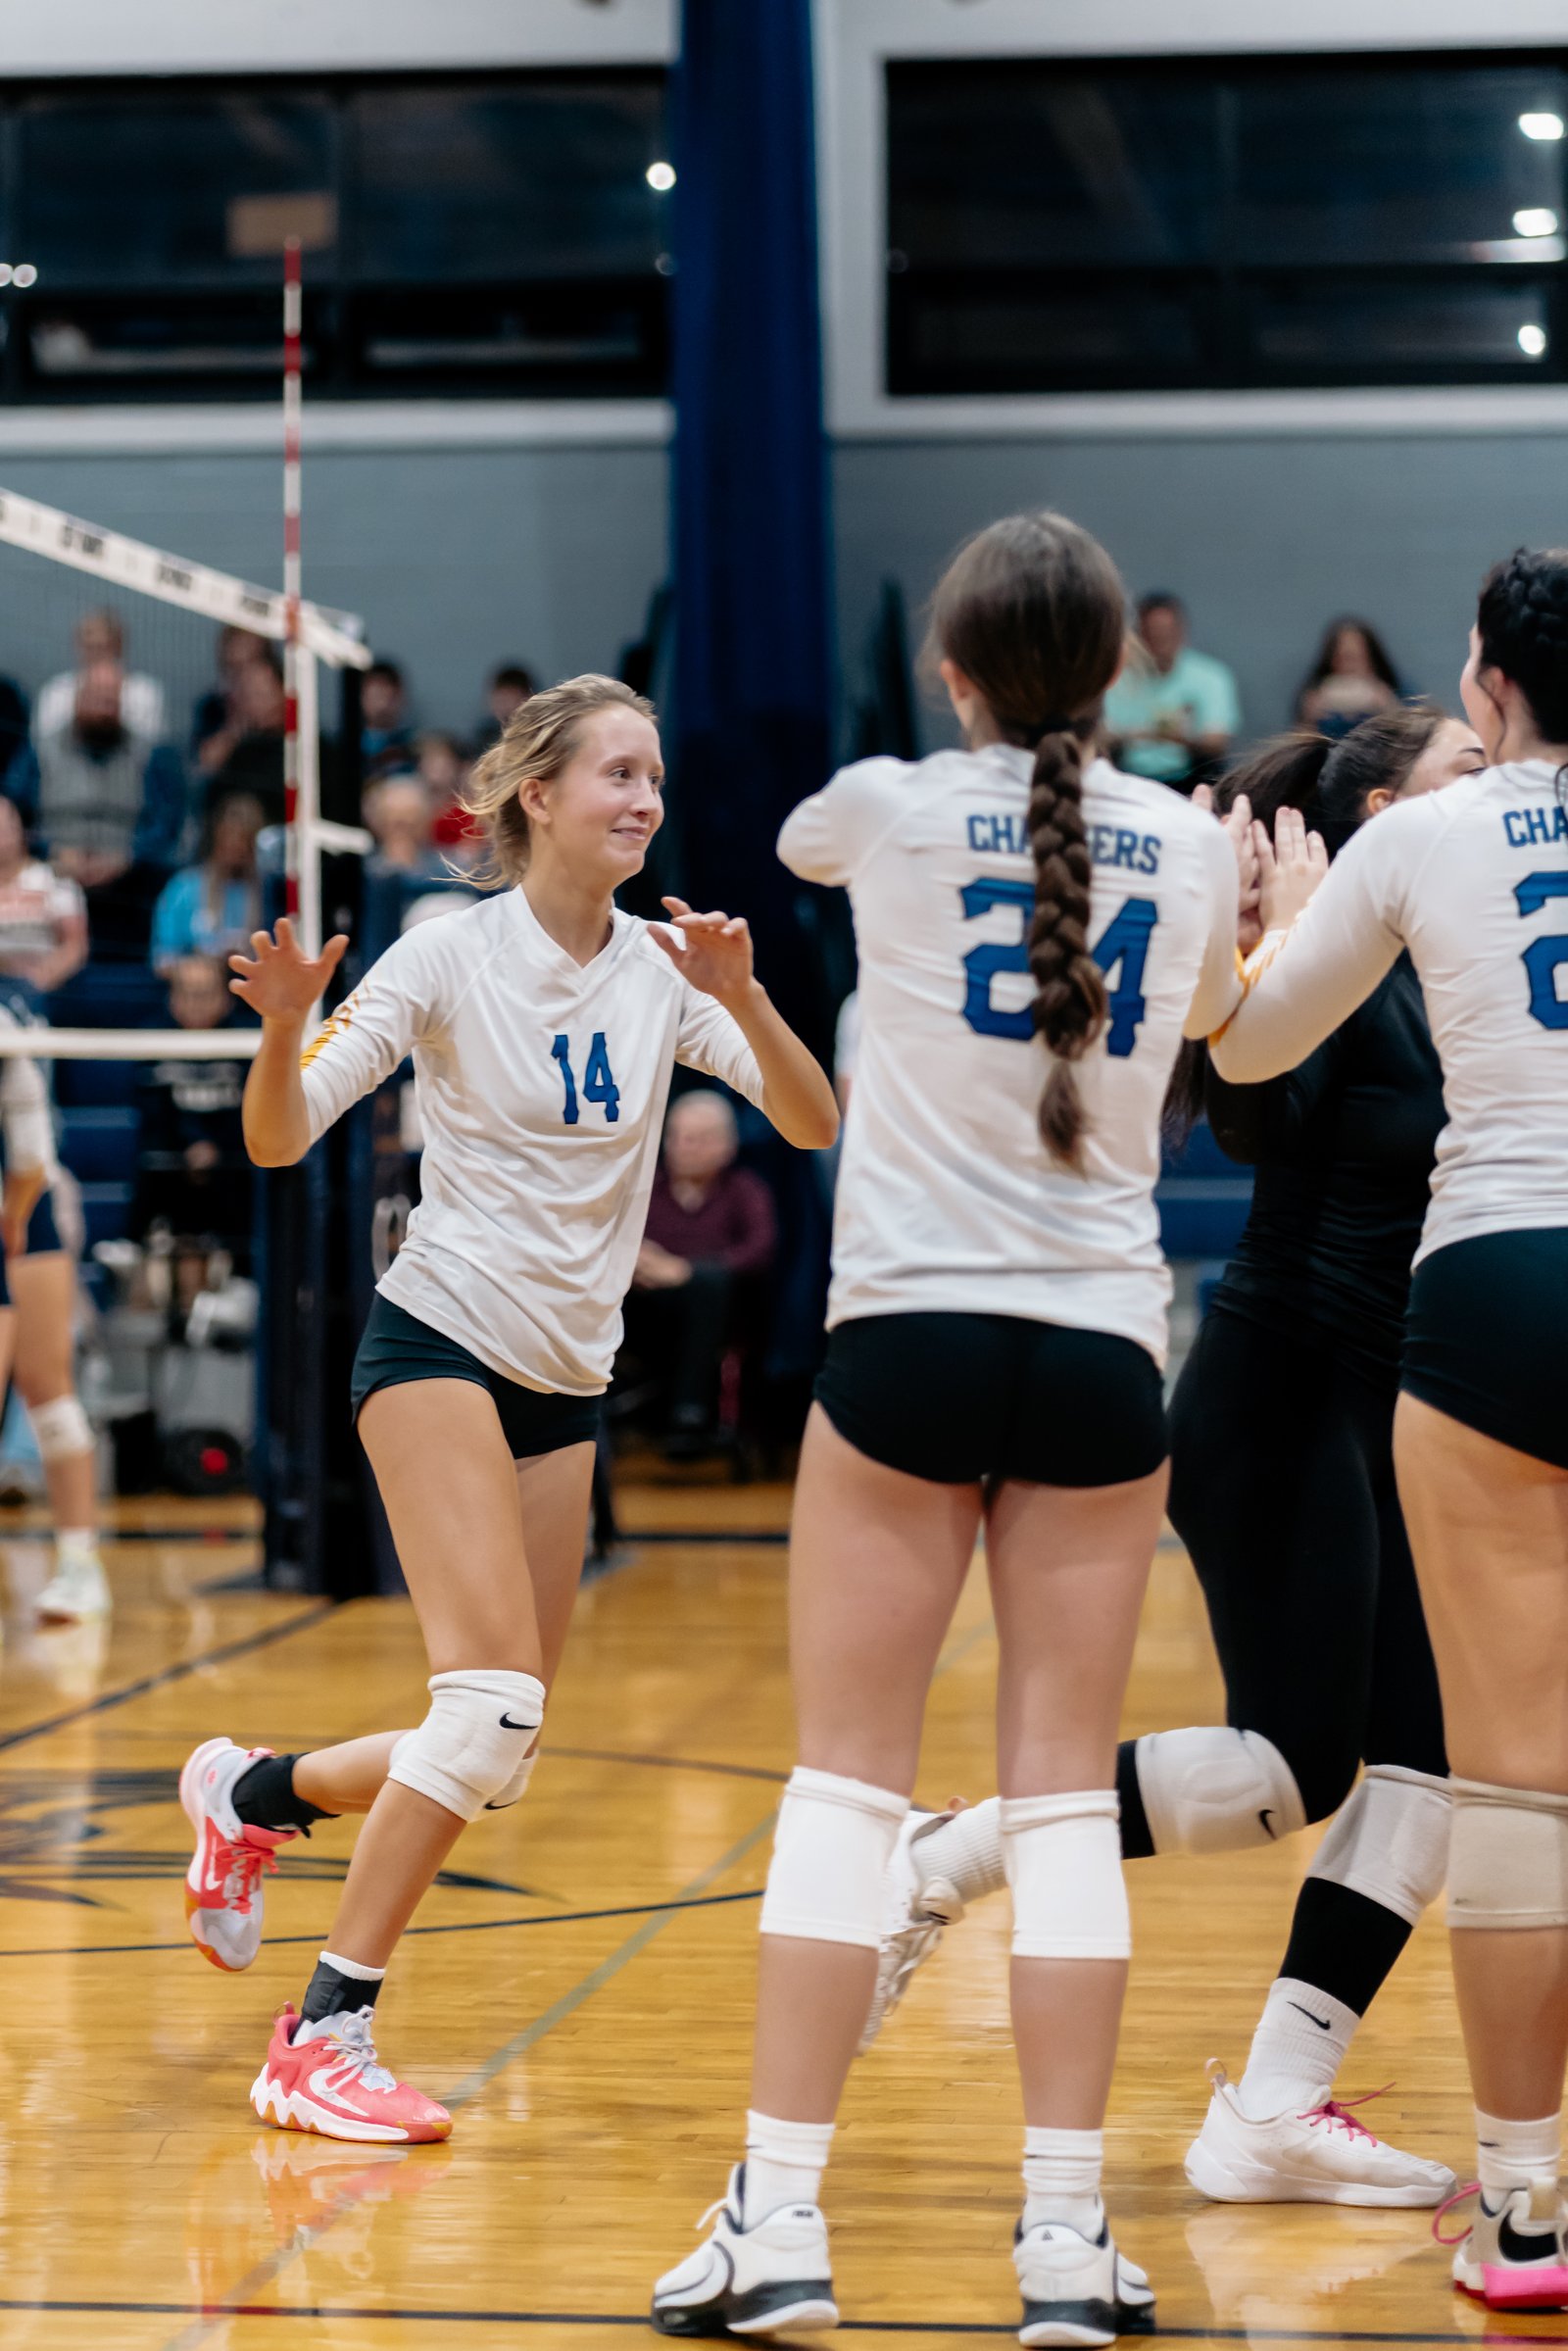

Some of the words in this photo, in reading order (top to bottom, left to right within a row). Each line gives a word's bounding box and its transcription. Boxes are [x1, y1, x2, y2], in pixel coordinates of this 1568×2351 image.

[966, 814, 1162, 875] CHERS
[958, 876, 1158, 1058] 24
[551, 1032, 620, 1125] 14
